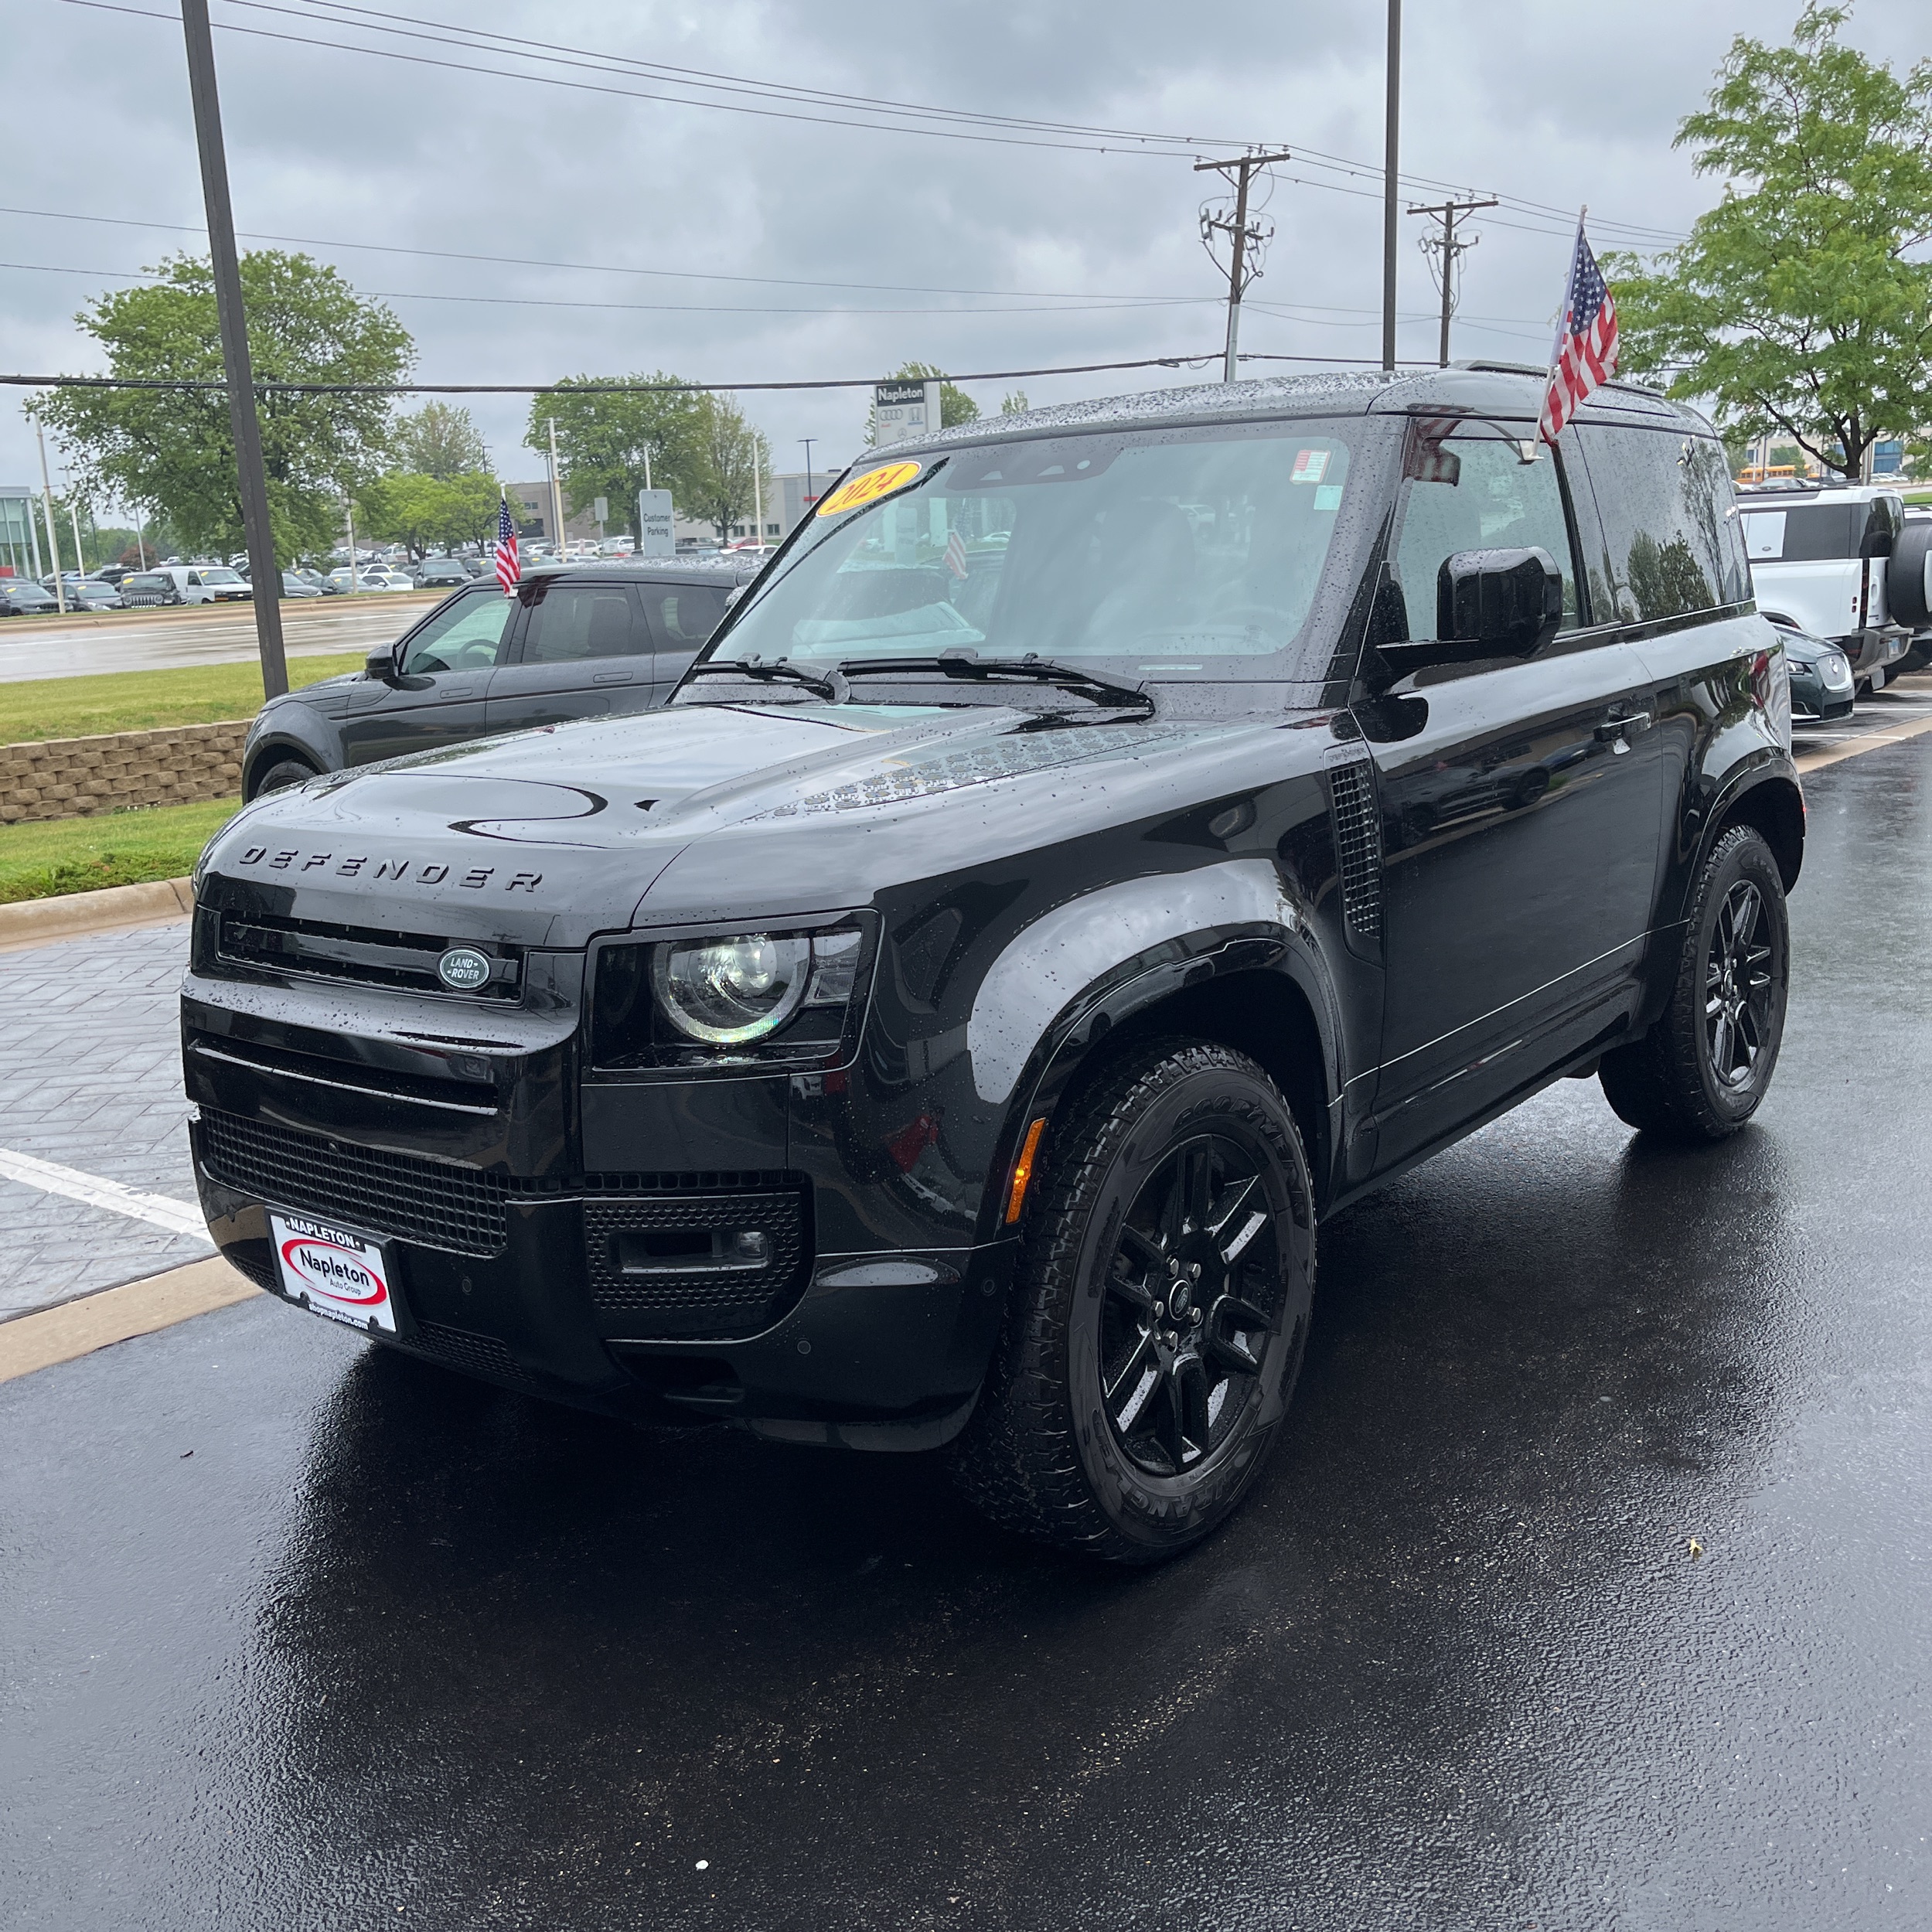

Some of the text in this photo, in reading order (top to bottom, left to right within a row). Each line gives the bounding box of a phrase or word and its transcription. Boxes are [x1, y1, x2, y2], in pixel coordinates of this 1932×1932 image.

[877, 387, 923, 403] Napleton
[825, 465, 908, 513] 2024
[643, 513, 671, 523] Customer
[647, 526, 669, 537] Parking
[239, 844, 543, 892] DEFENDER
[450, 957, 473, 969] LAND
[451, 968, 479, 980] ROVER
[289, 1217, 356, 1249] NAPLETON
[299, 1247, 370, 1286] Napleton
[330, 1278, 361, 1296] Auto Group
[308, 1303, 369, 1331] shopnapleton.com
